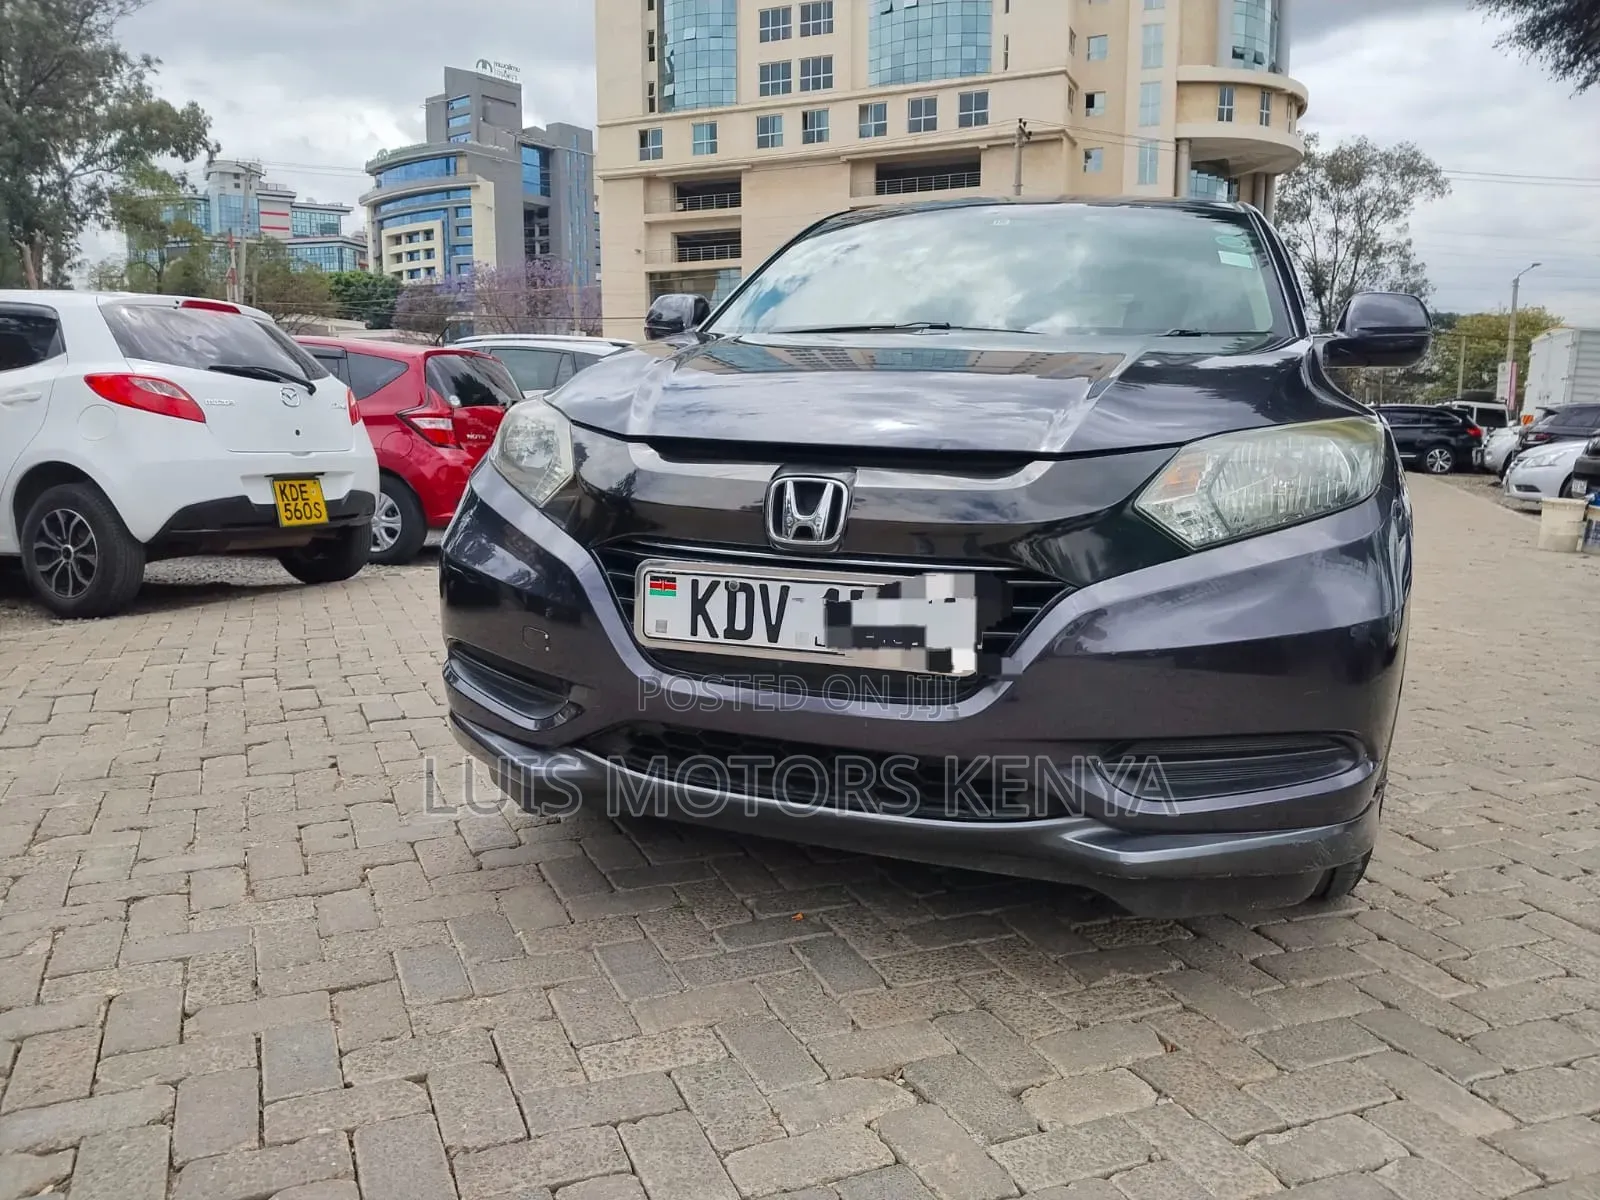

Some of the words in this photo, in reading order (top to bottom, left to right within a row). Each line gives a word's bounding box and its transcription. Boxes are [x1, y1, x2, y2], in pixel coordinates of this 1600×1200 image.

[278, 483, 308, 502] KDE
[284, 502, 323, 521] 560S
[690, 578, 791, 643] KDV
